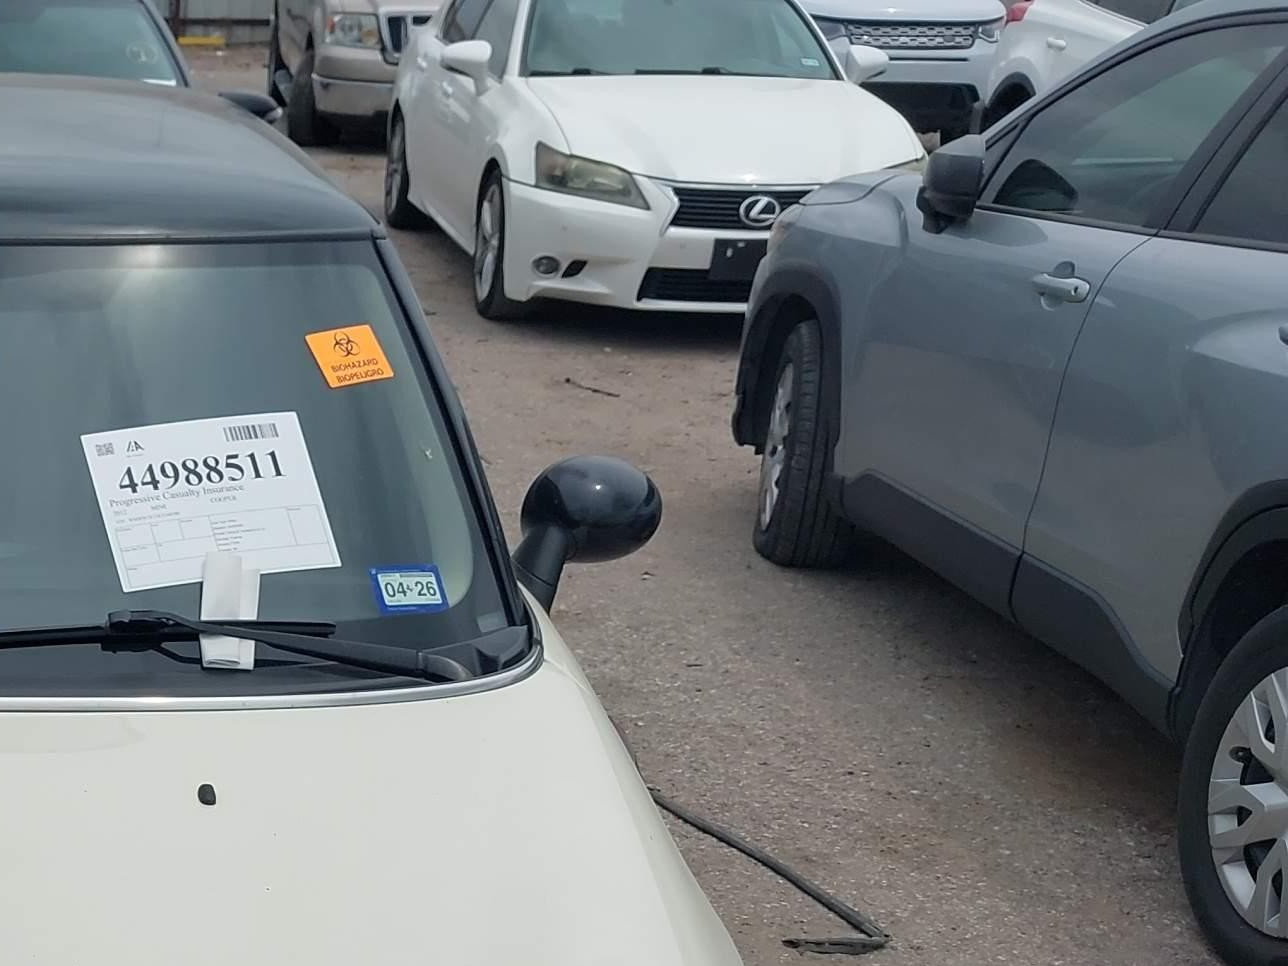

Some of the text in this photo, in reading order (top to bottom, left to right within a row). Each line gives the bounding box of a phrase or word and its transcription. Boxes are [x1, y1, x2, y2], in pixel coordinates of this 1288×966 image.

[331, 358, 379, 373] BIOHAZARD
[336, 367, 385, 384] BIOPELIGRO
[118, 449, 287, 493] 44988511
[108, 484, 245, 508] Progressive Casualty Insurance
[384, 580, 438, 599] 04 26
